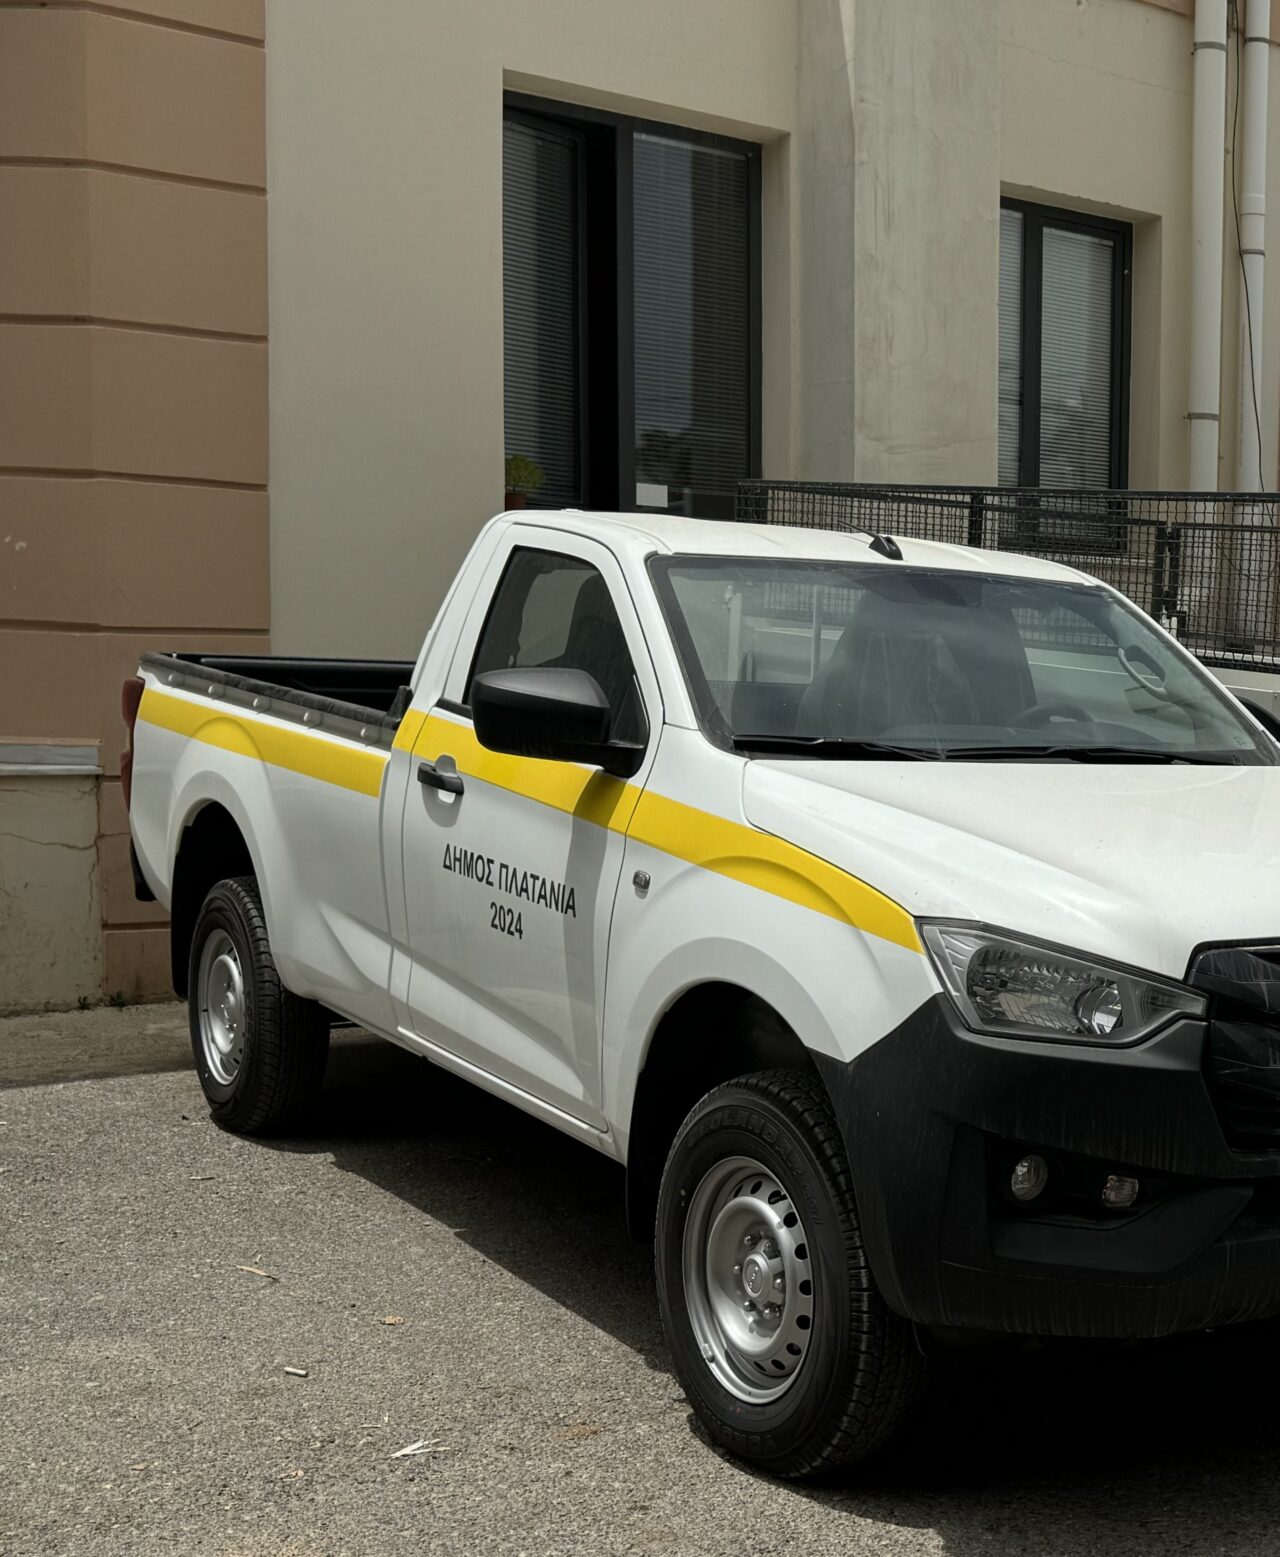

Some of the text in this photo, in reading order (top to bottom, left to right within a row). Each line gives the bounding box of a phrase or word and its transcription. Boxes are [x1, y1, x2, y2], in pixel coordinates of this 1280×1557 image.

[443, 843, 577, 918] ΔΗΜΟΣ ΠΛΑΤΑΝΙΑ
[490, 901, 523, 940] 2024
